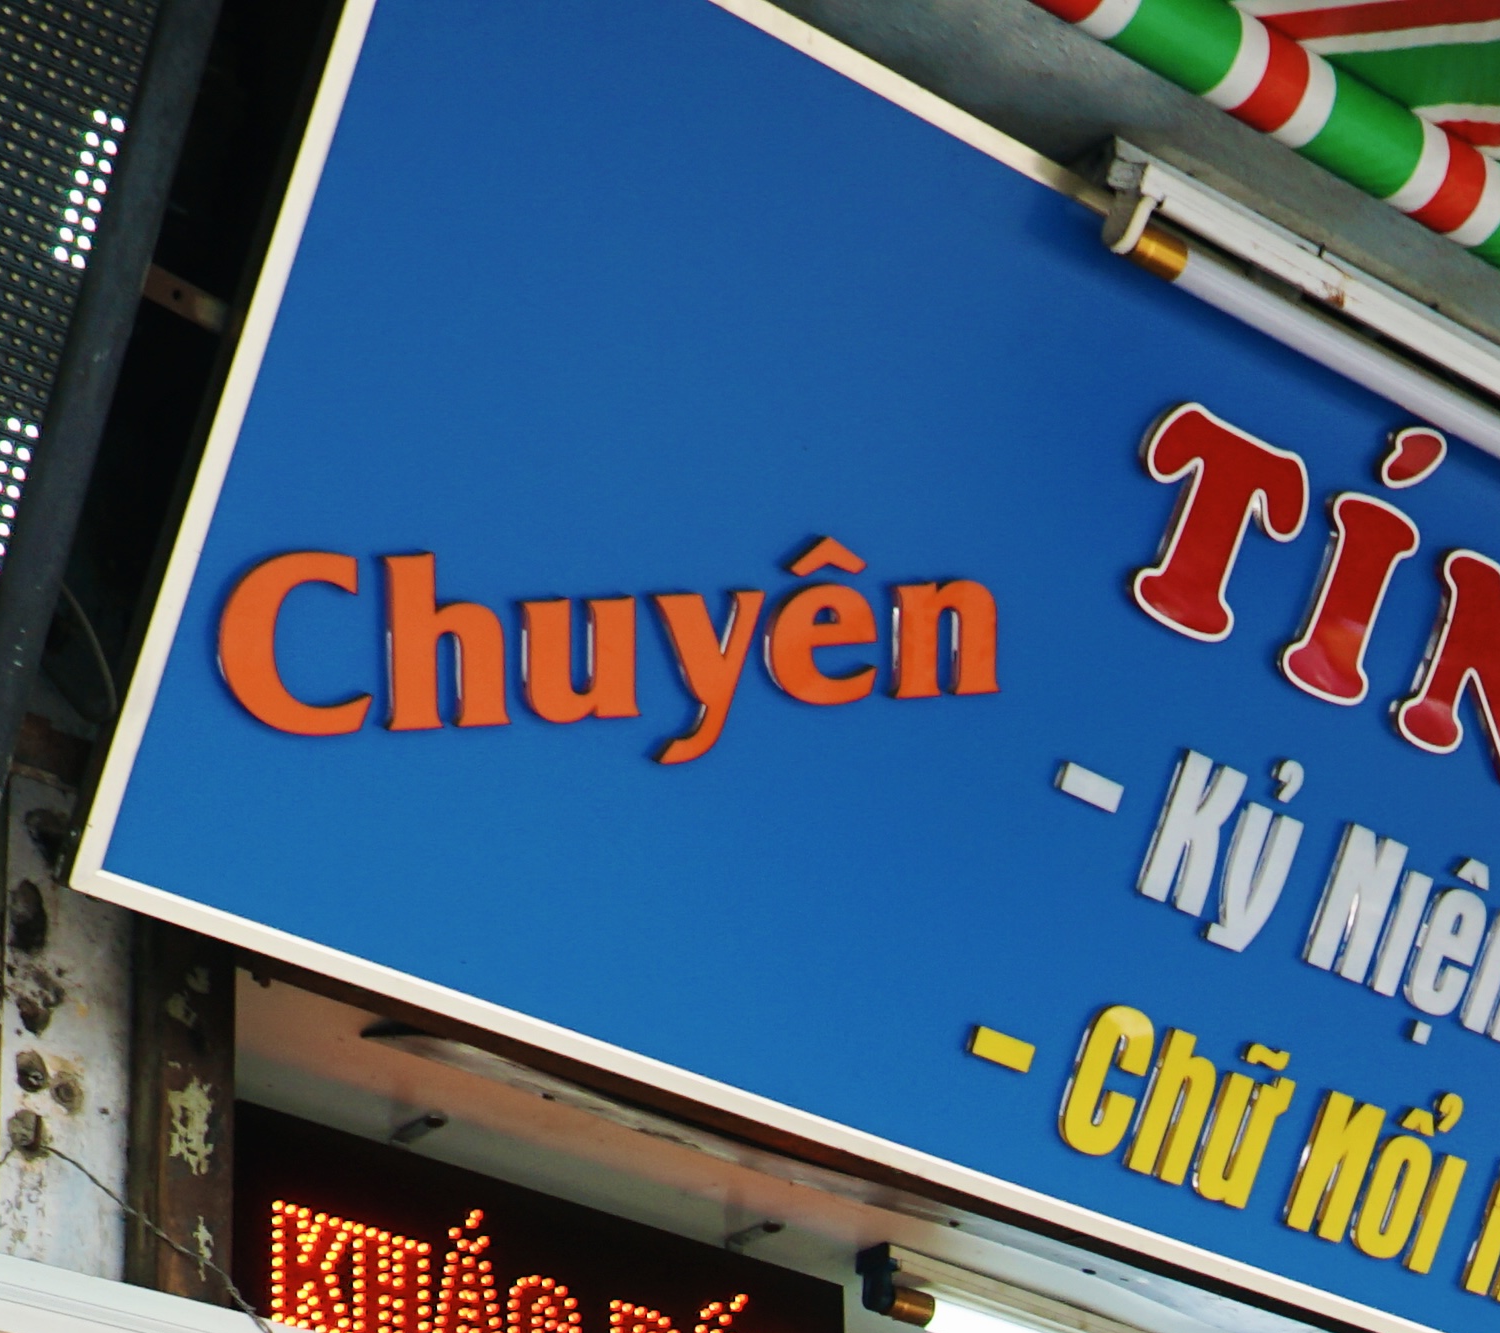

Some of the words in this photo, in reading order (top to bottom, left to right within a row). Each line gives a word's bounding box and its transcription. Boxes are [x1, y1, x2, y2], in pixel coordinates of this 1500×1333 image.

[215, 535, 1002, 766] Chuyên
[1135, 747, 1307, 954] Kỷ
[1056, 1003, 1297, 1211] Chữ
[1282, 1090, 1469, 1277] Nổi
